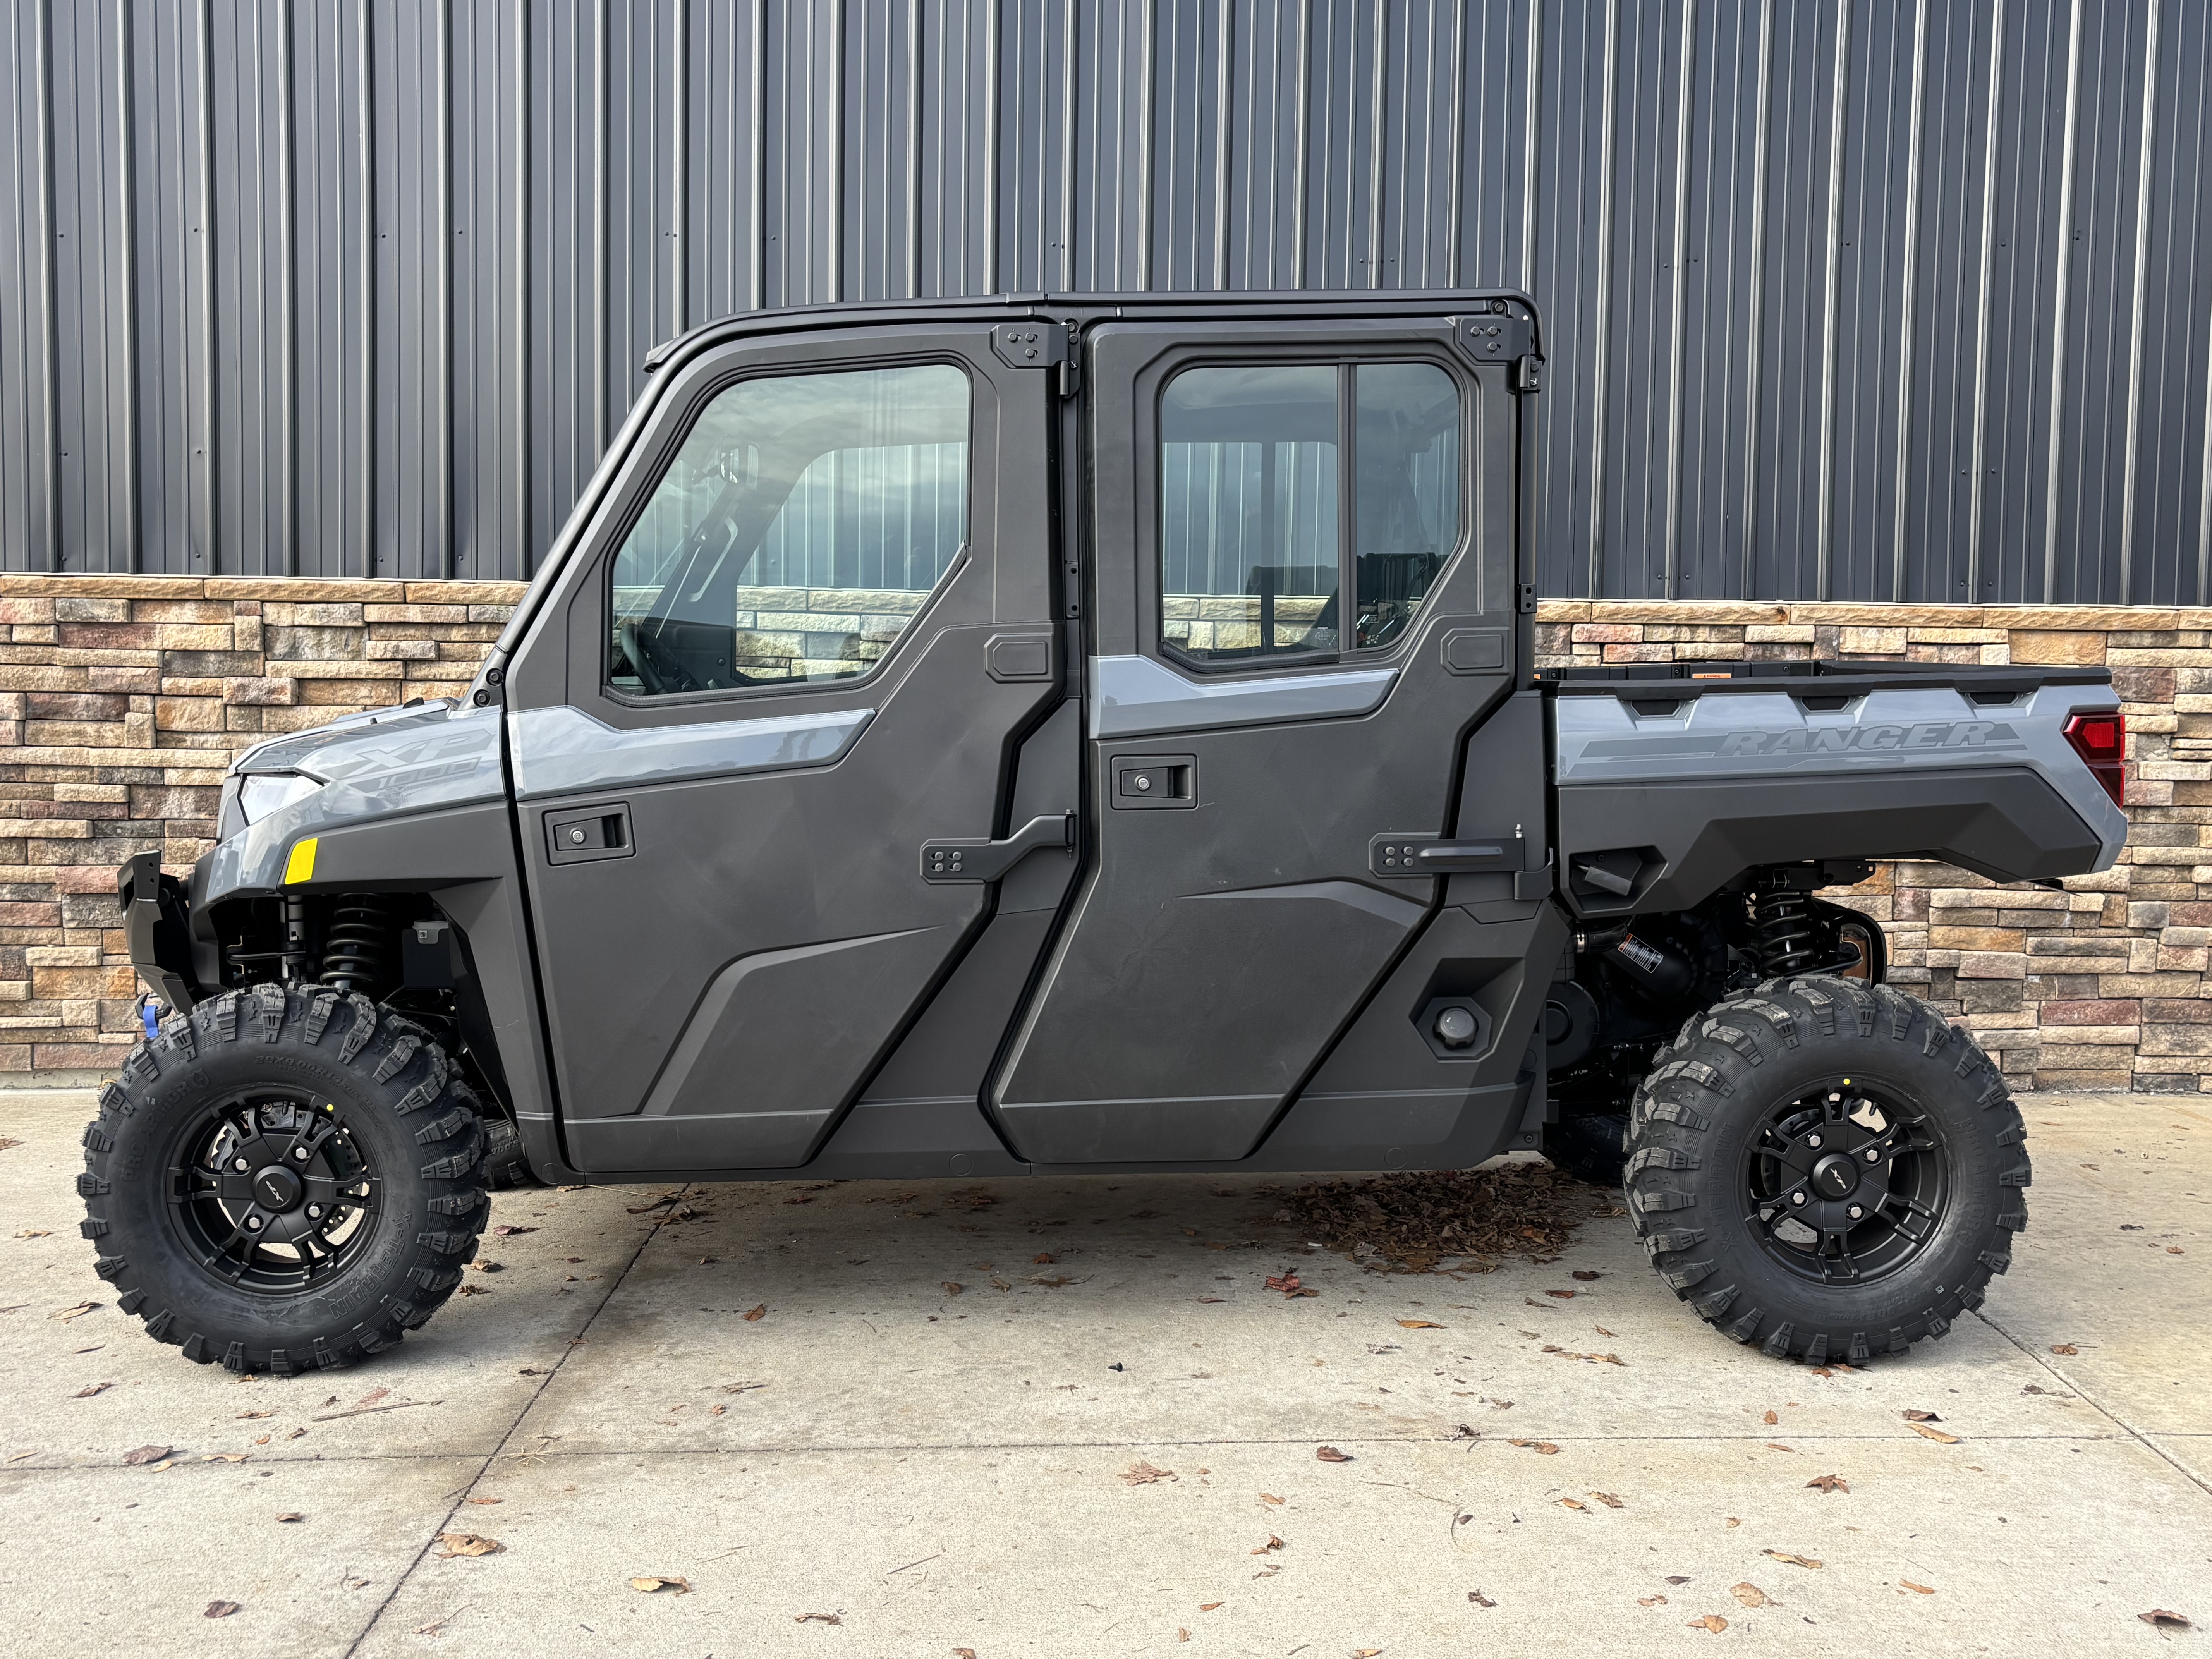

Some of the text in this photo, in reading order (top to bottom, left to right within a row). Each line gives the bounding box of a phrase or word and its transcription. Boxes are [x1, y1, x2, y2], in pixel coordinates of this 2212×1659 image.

[340, 728, 493, 779] XP
[1714, 721, 1996, 757] RANGER
[378, 756, 482, 789] 1000
[122, 1082, 192, 1181] PRO ARMOR
[266, 1180, 284, 1202] XP
[1708, 1122, 1738, 1252] X-TERRAIN
[1830, 1168, 1846, 1189] XP
[329, 1210, 411, 1319] X-TERRAIN
